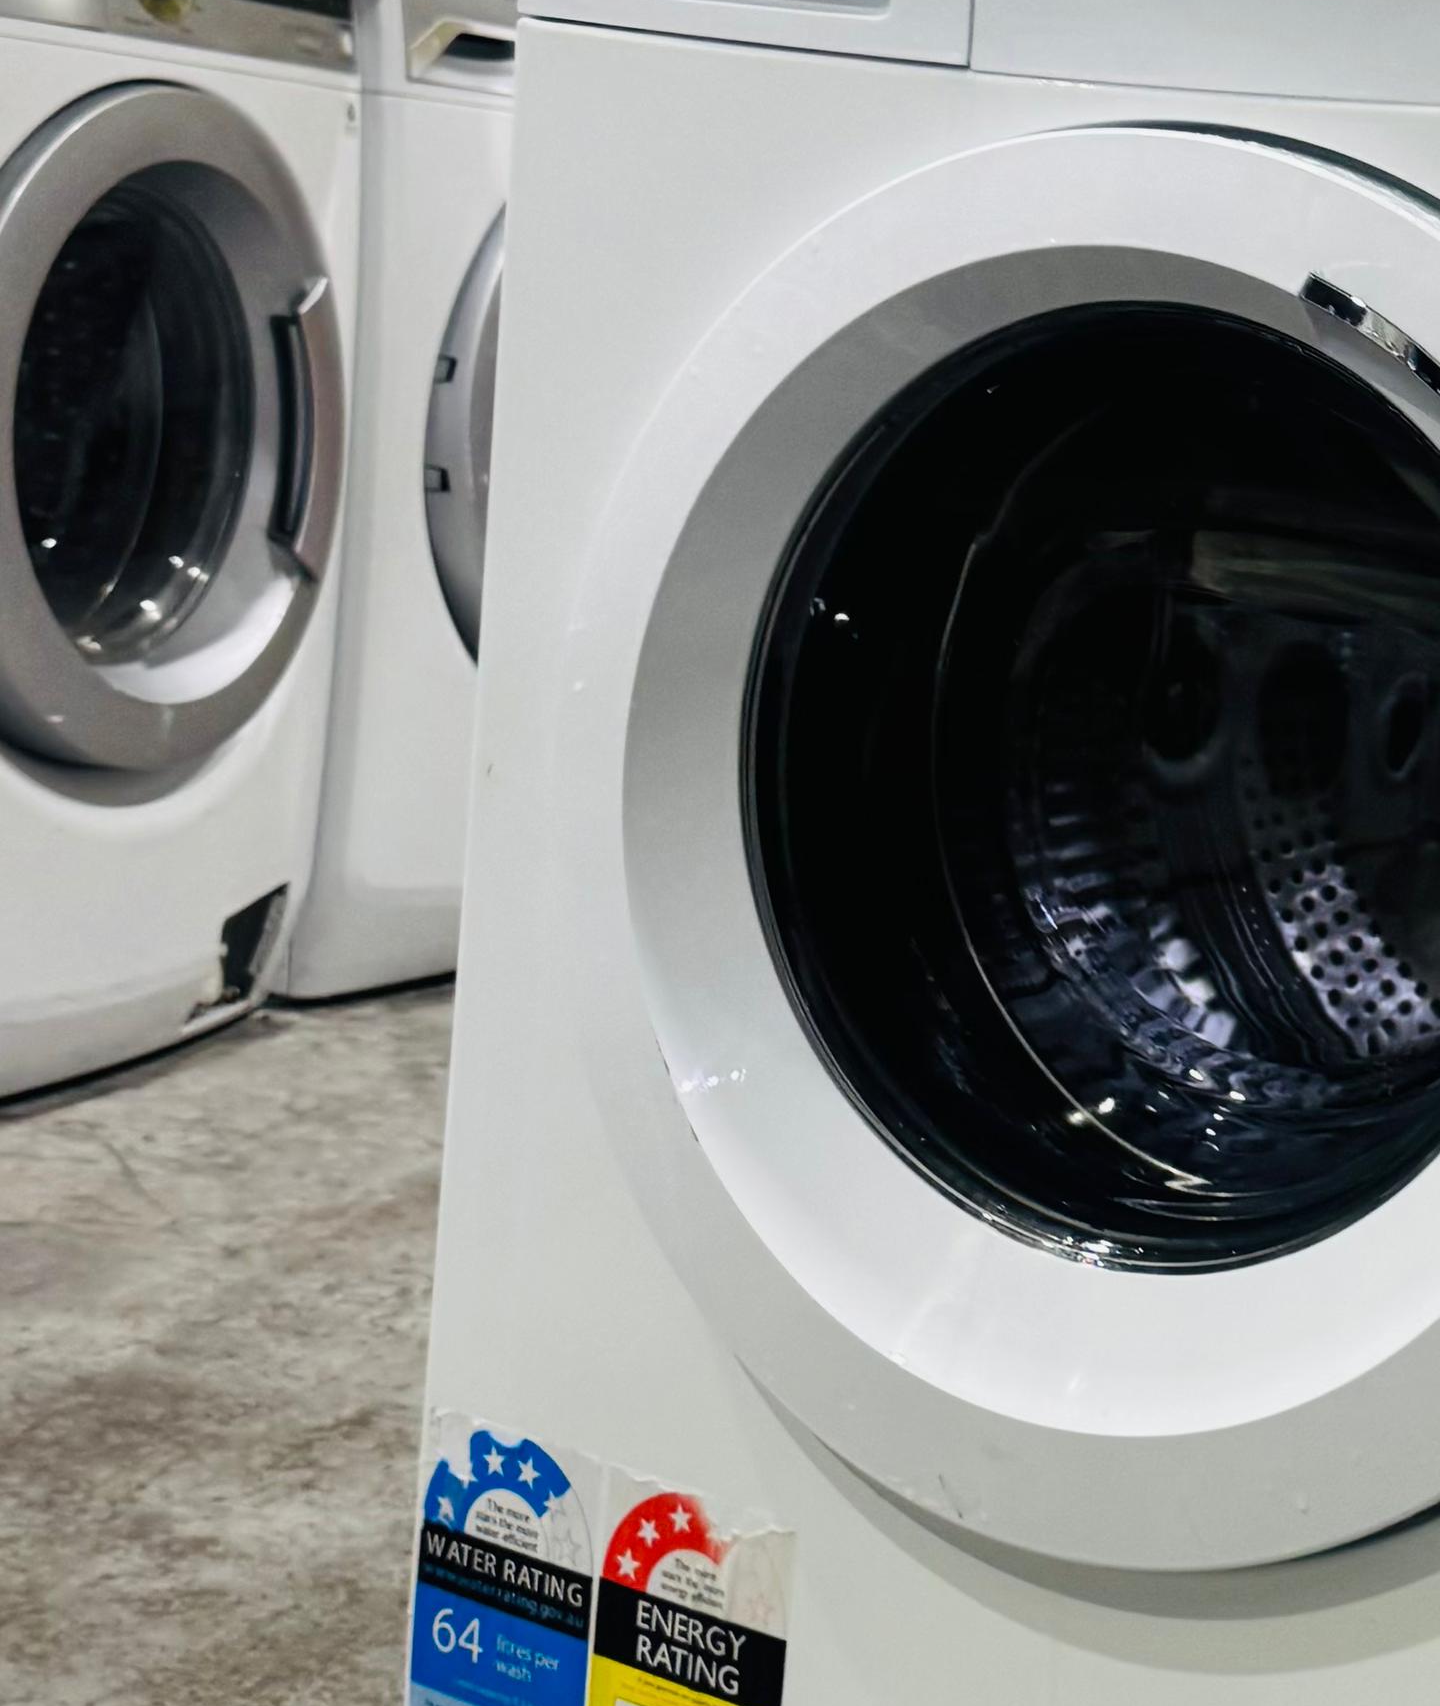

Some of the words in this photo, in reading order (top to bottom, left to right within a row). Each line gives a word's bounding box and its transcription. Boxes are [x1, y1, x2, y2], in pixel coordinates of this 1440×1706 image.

[487, 1497, 505, 1514] The
[506, 1507, 531, 1523] more
[426, 1530, 498, 1579] WATER
[503, 1558, 584, 1609] RATING
[432, 1608, 484, 1664] 64
[636, 1599, 747, 1661] ENERGY
[495, 1659, 532, 1683] wash
[533, 1651, 561, 1672] per
[636, 1634, 741, 1696] RATING
